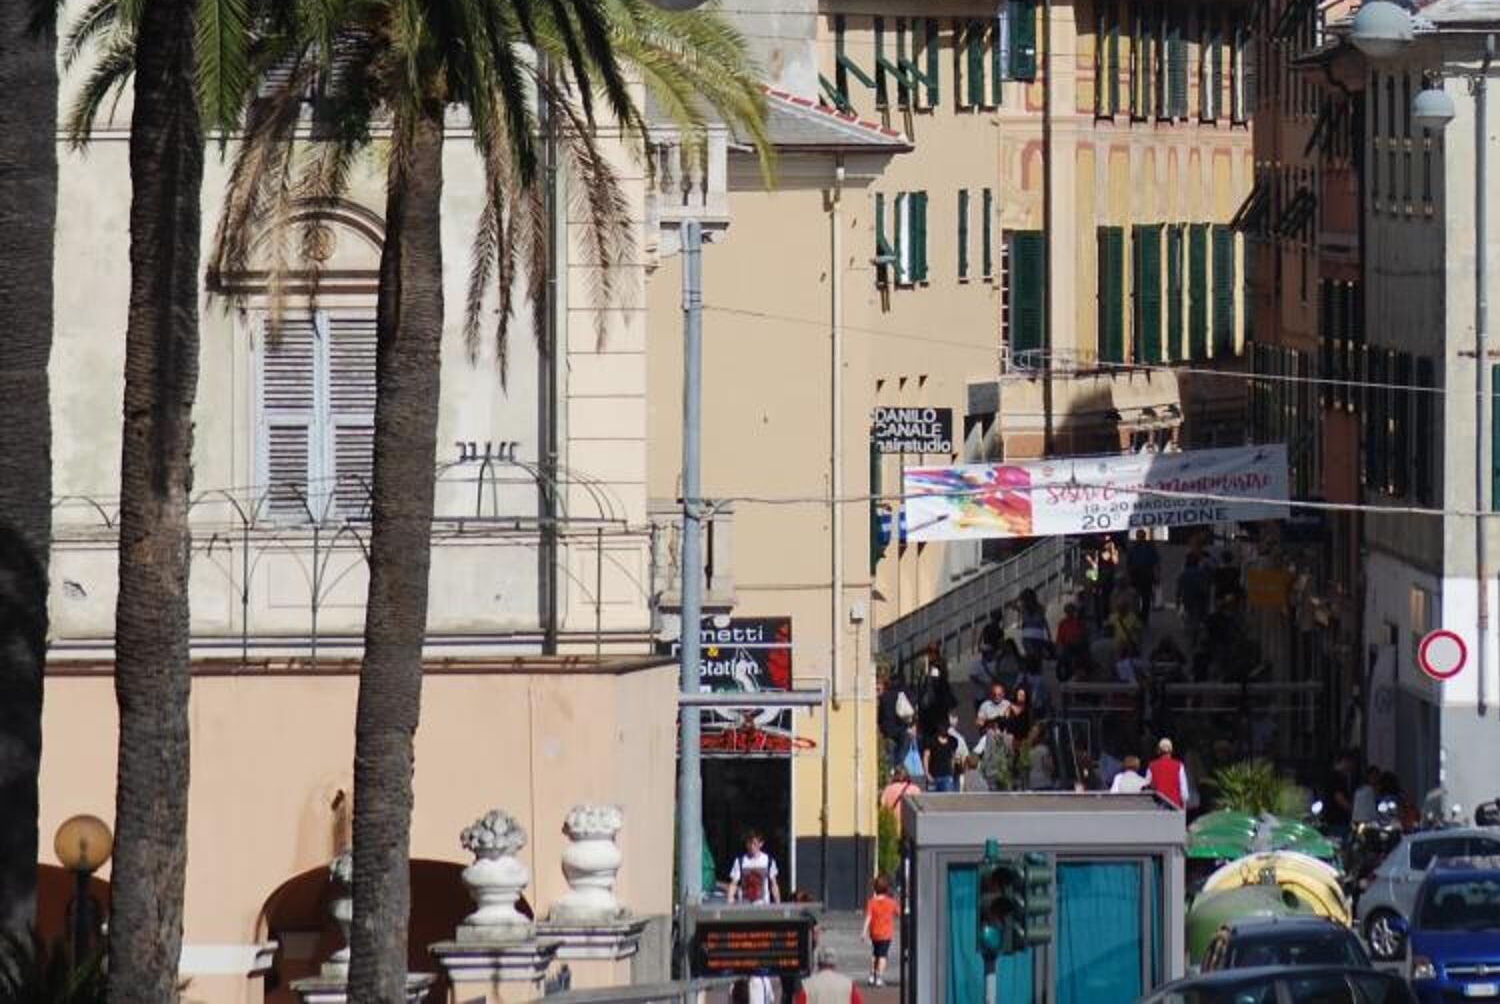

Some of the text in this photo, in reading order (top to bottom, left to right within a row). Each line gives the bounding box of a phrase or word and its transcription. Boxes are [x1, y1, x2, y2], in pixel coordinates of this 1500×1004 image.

[875, 408, 937, 423] DANILO
[875, 423, 943, 437] CANALE
[1127, 507, 1230, 528] EDIZIONE
